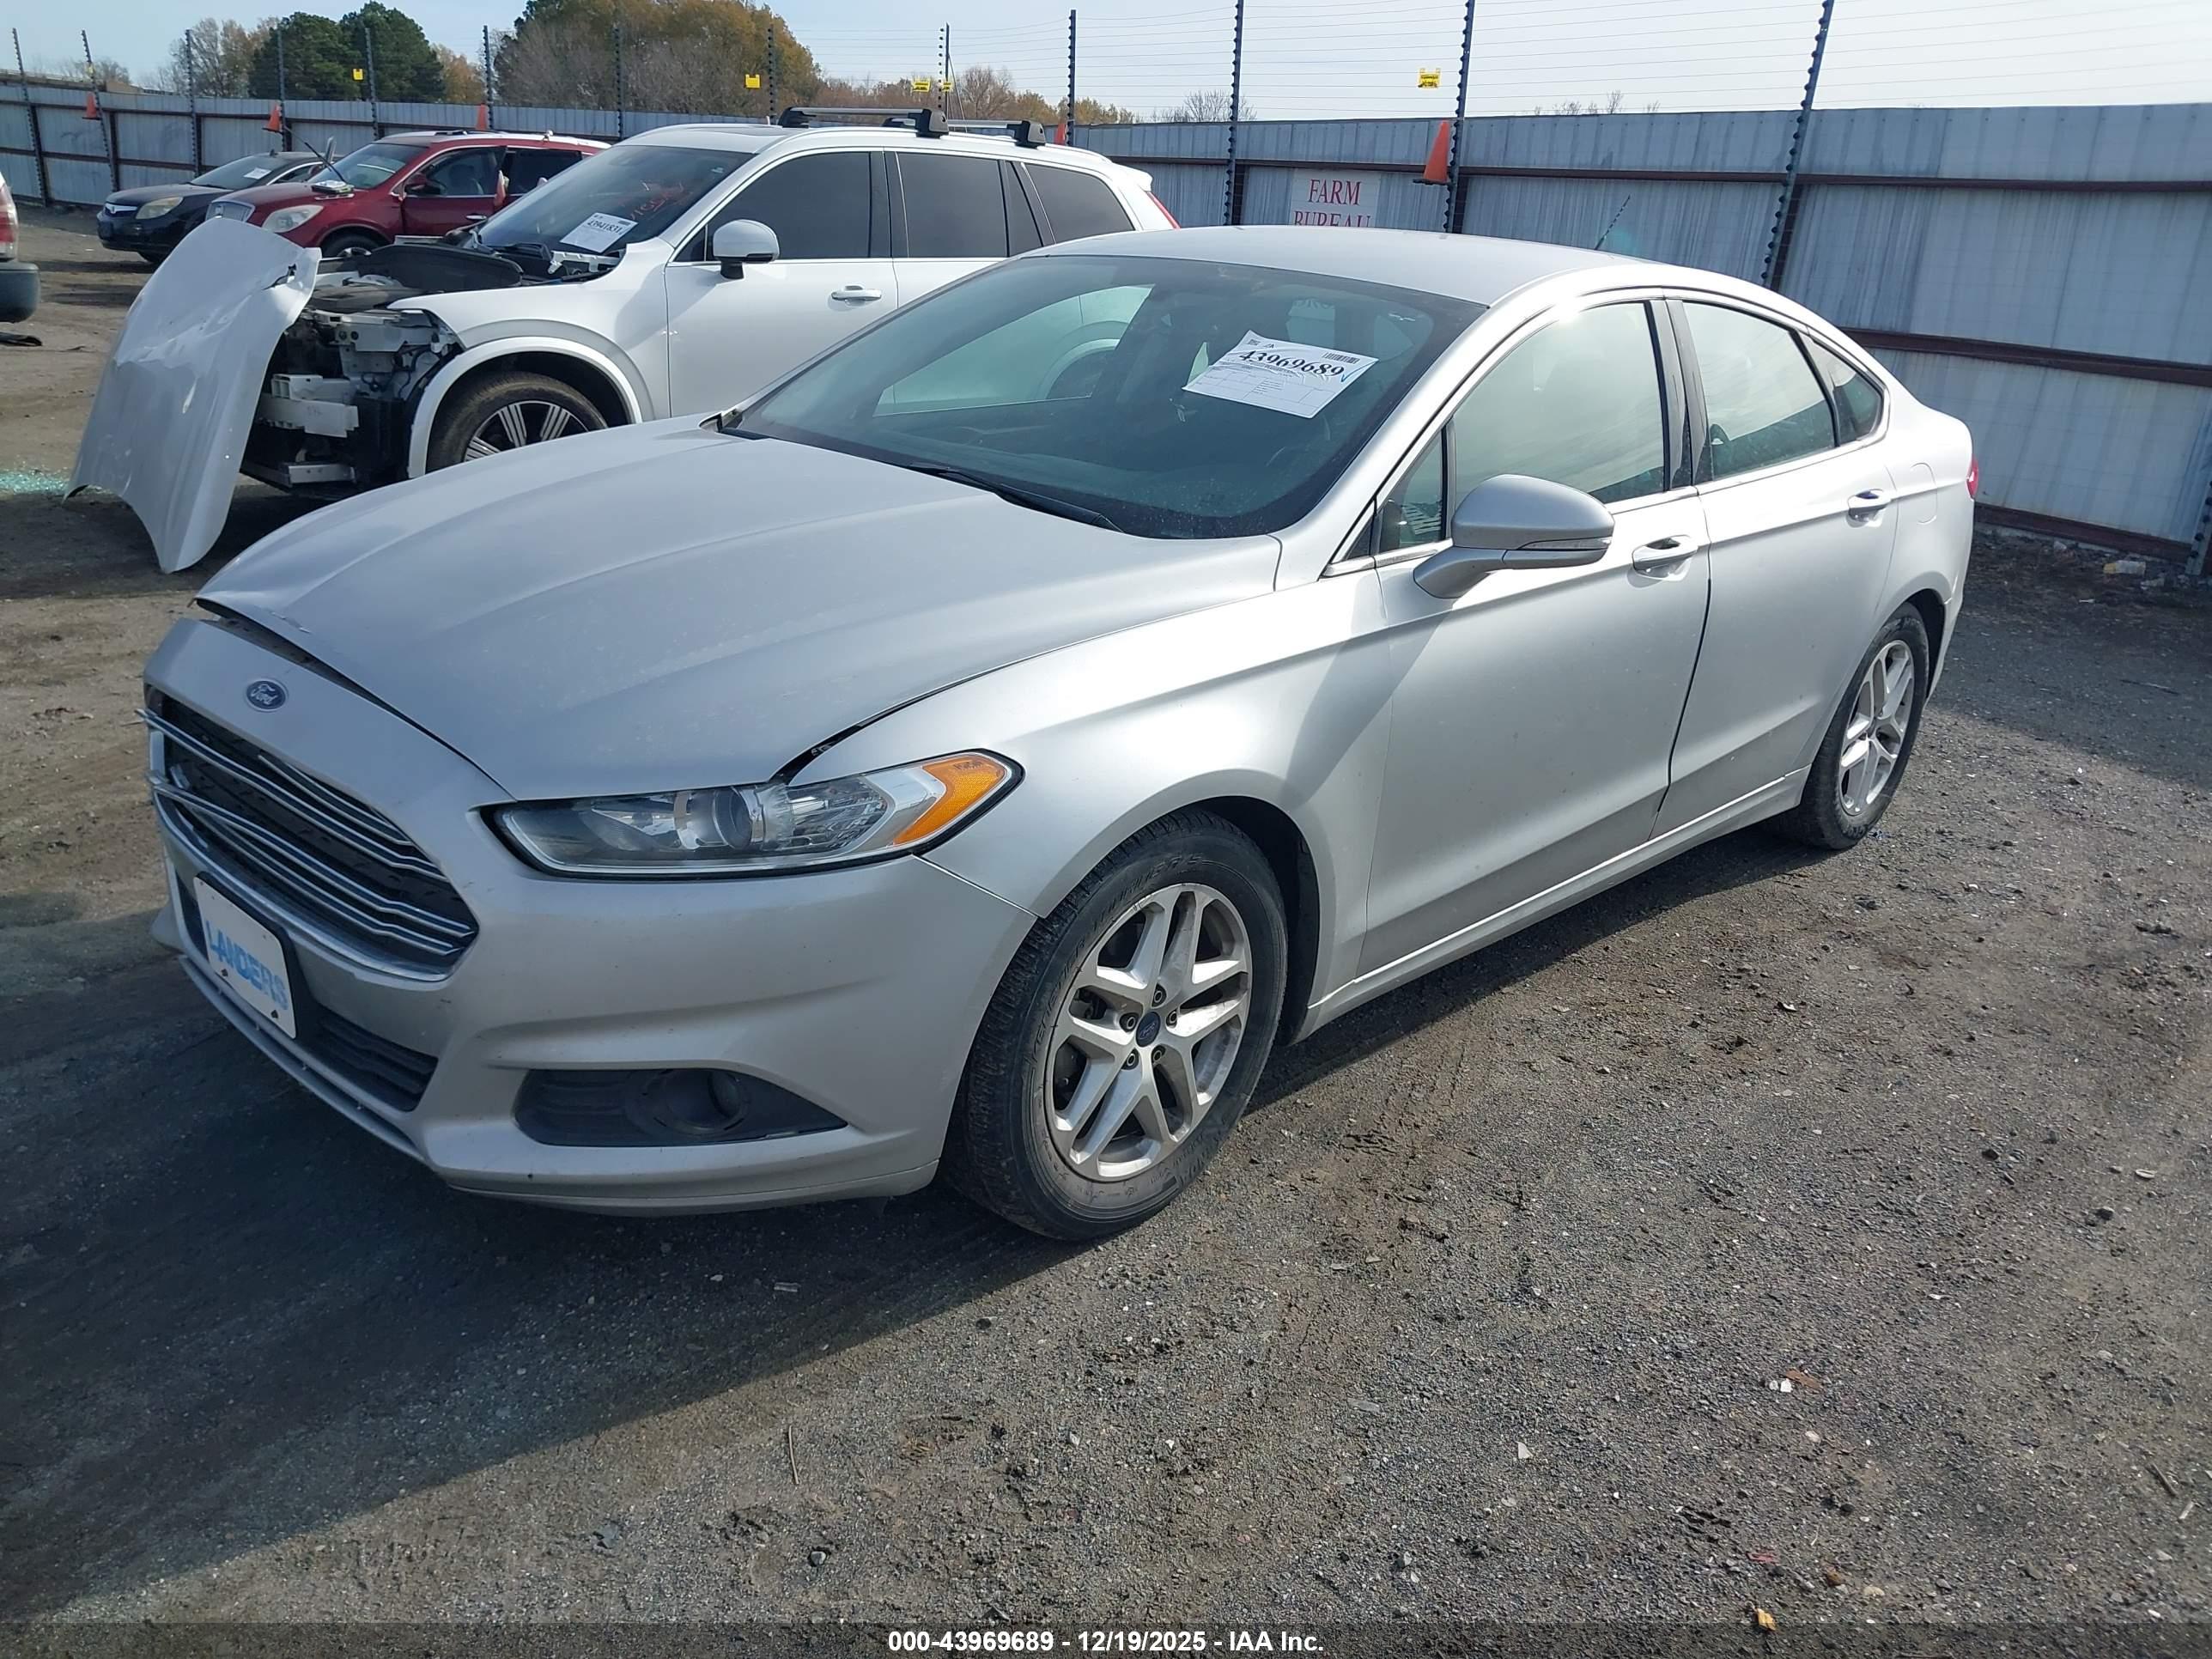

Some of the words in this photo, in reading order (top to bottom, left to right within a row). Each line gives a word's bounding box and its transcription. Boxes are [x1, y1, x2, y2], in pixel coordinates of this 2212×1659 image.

[1308, 179, 1362, 205] FARM
[1238, 350, 1345, 377] 43969689
[205, 920, 289, 1011] LANDERS
